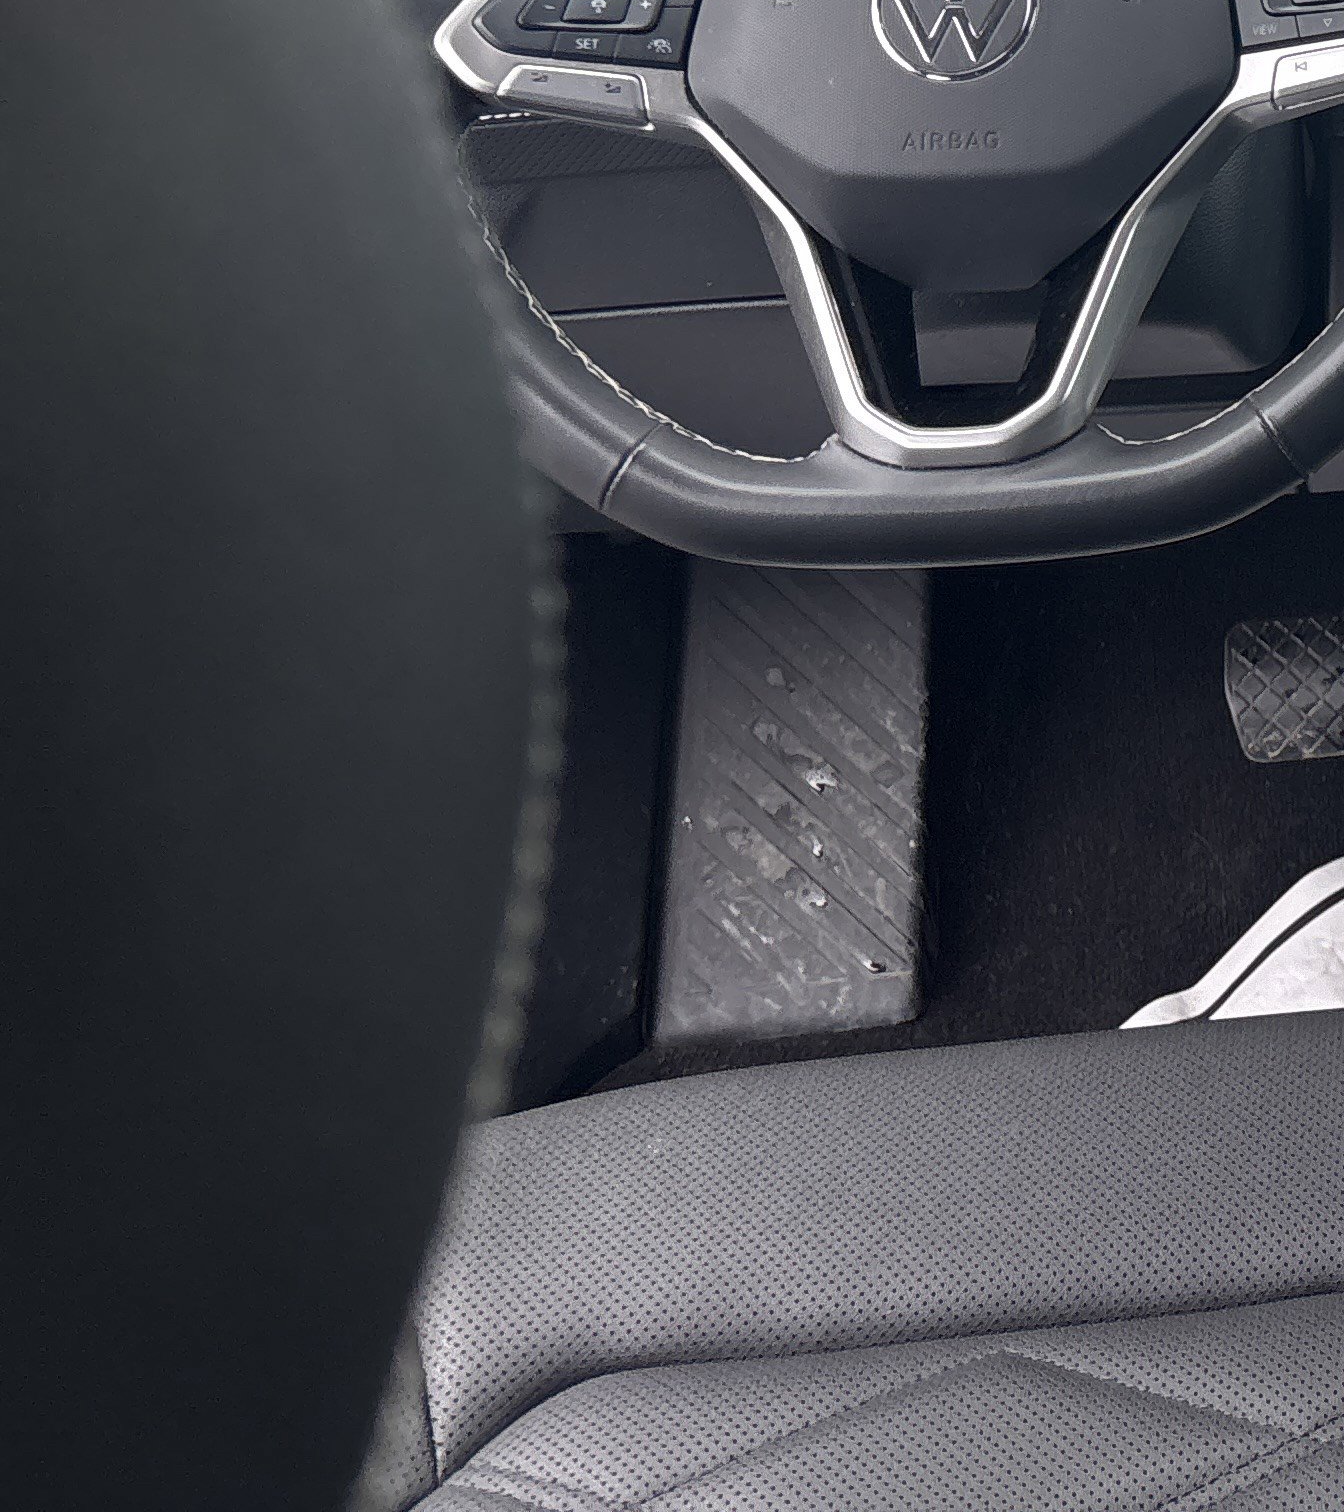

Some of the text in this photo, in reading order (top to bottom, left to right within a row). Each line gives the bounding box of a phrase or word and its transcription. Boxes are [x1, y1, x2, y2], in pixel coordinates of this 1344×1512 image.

[1252, 24, 1277, 36] VIEW
[575, 38, 599, 50] SET
[901, 131, 1001, 152] AIRBAG
